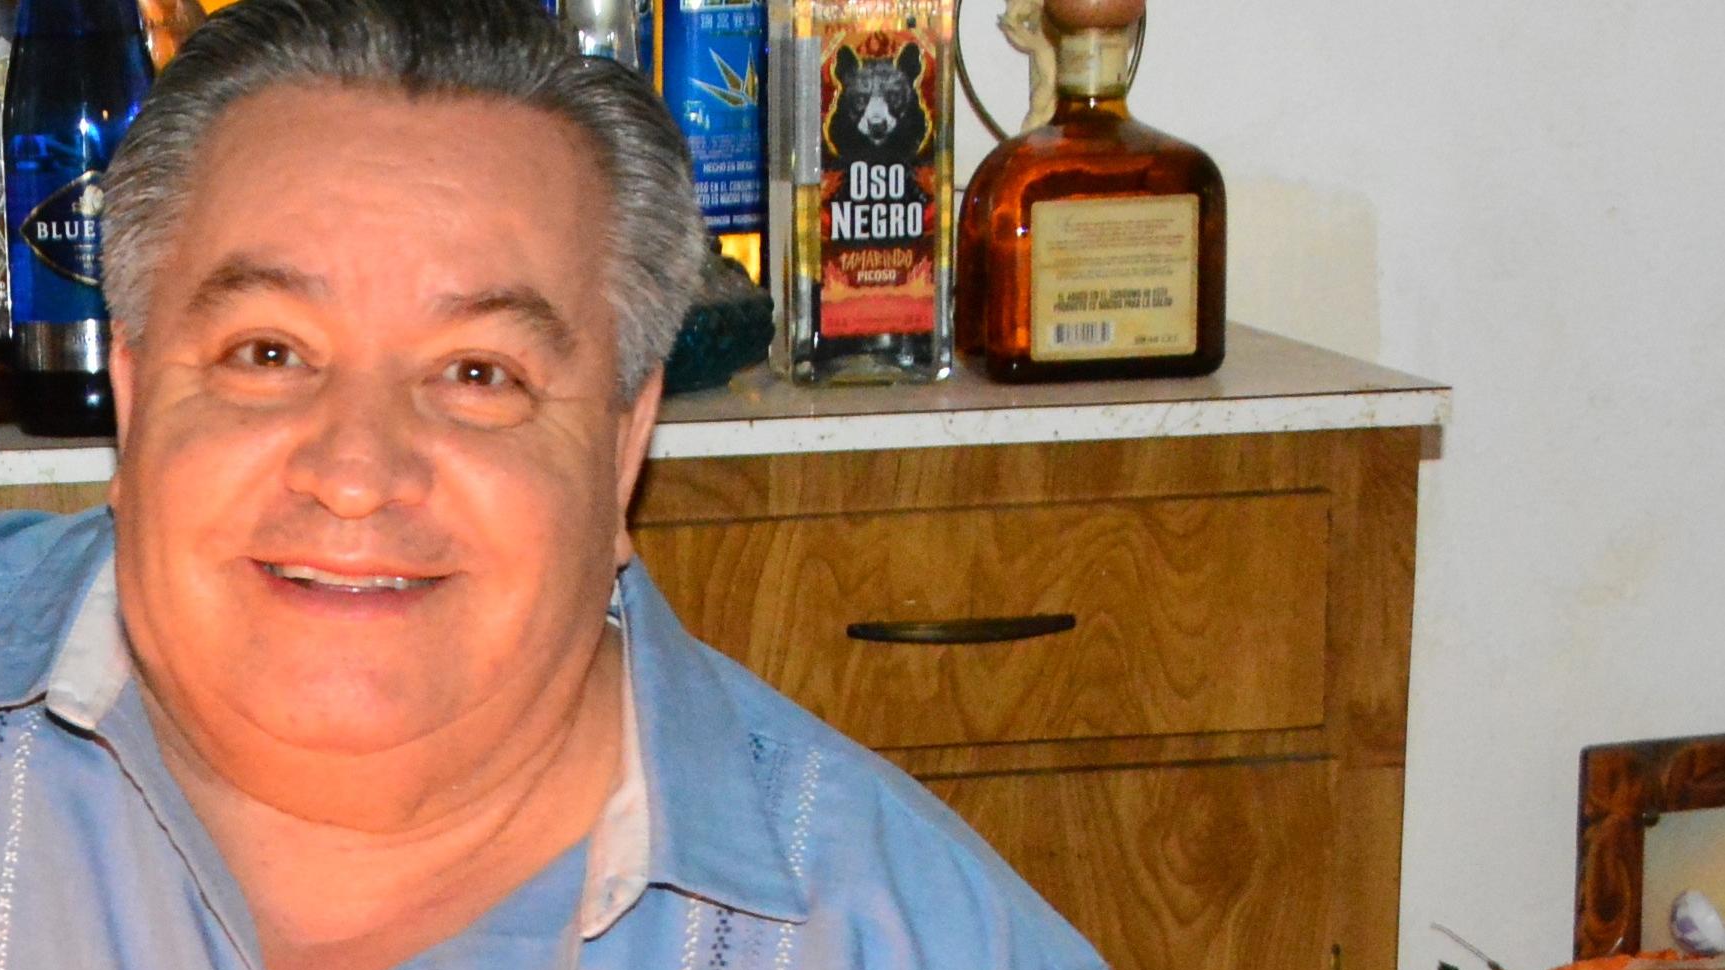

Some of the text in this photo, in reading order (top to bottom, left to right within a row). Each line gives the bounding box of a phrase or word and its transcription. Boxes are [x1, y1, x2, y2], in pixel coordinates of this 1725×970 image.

[850, 161, 905, 201] OSO
[37, 219, 96, 240] BLUE
[831, 201, 923, 241] NEGRO
[840, 247, 913, 272] TAMARINDO
[857, 268, 896, 284] PICOSO
